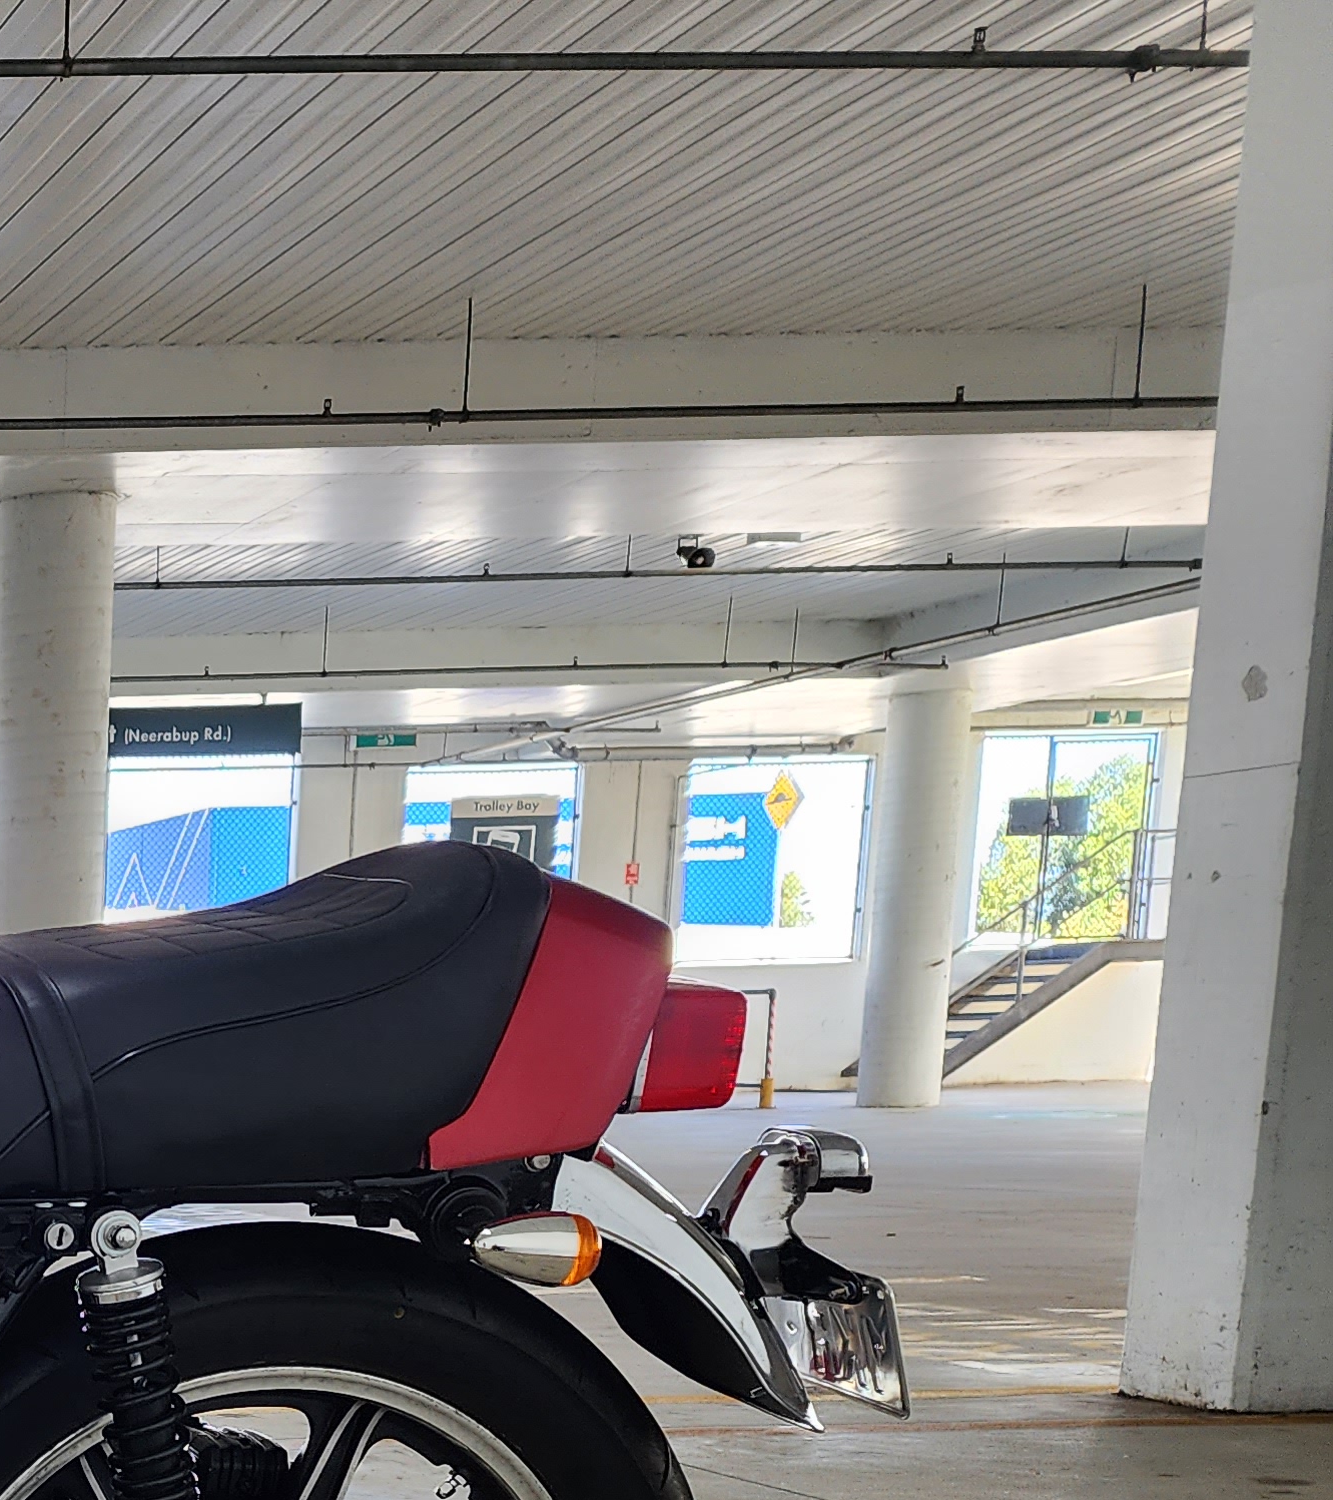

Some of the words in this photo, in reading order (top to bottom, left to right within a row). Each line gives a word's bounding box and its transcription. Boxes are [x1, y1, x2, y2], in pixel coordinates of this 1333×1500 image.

[124, 725, 200, 745] (Neerabup
[204, 724, 232, 743] Rd.)
[474, 800, 514, 813] Trolley
[516, 800, 540, 813] Bay
